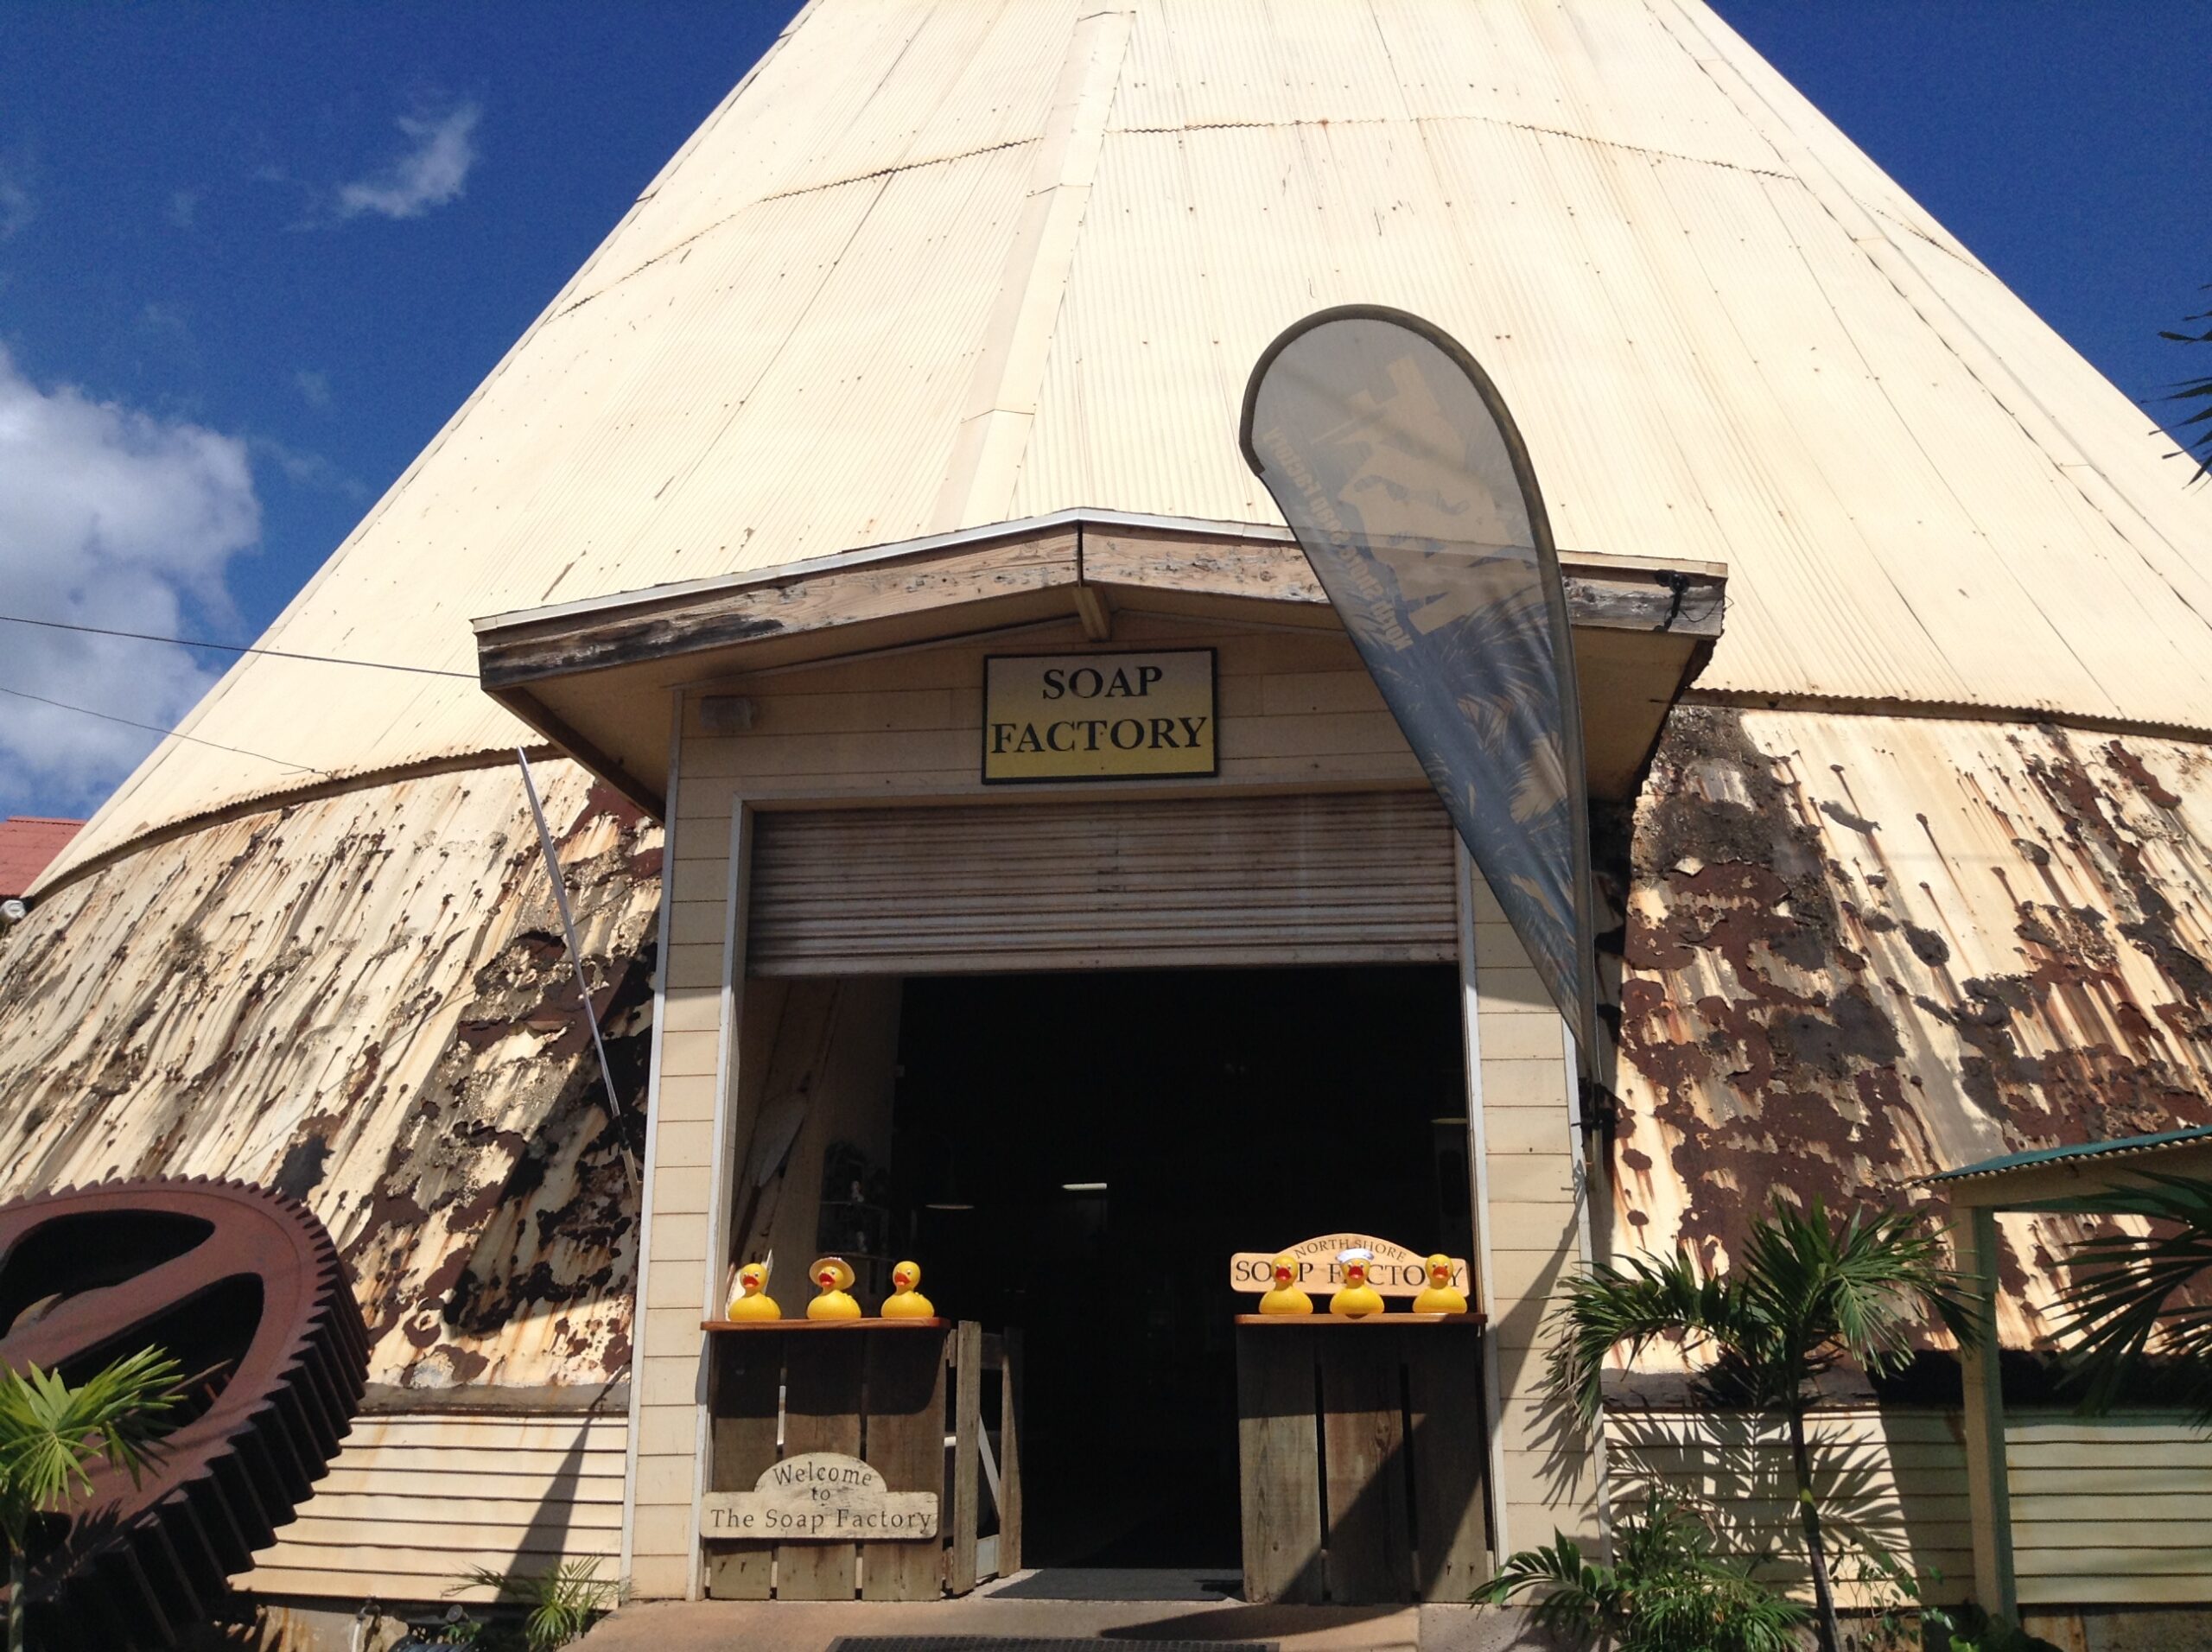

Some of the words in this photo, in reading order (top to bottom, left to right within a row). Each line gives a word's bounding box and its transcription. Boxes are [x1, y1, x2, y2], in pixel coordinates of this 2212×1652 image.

[1042, 665, 1163, 699] SOAP
[990, 716, 1207, 754] FACTORY
[1294, 1238, 1350, 1259] NORTH
[1354, 1239, 1408, 1262] SHORE
[1235, 1261, 1313, 1282] SOP
[1326, 1261, 1464, 1287] FCTOY
[772, 1461, 872, 1487] Welcome
[811, 1486, 830, 1501] to
[710, 1509, 754, 1528] The
[766, 1509, 824, 1534] Soap
[836, 1509, 932, 1534] Factory
